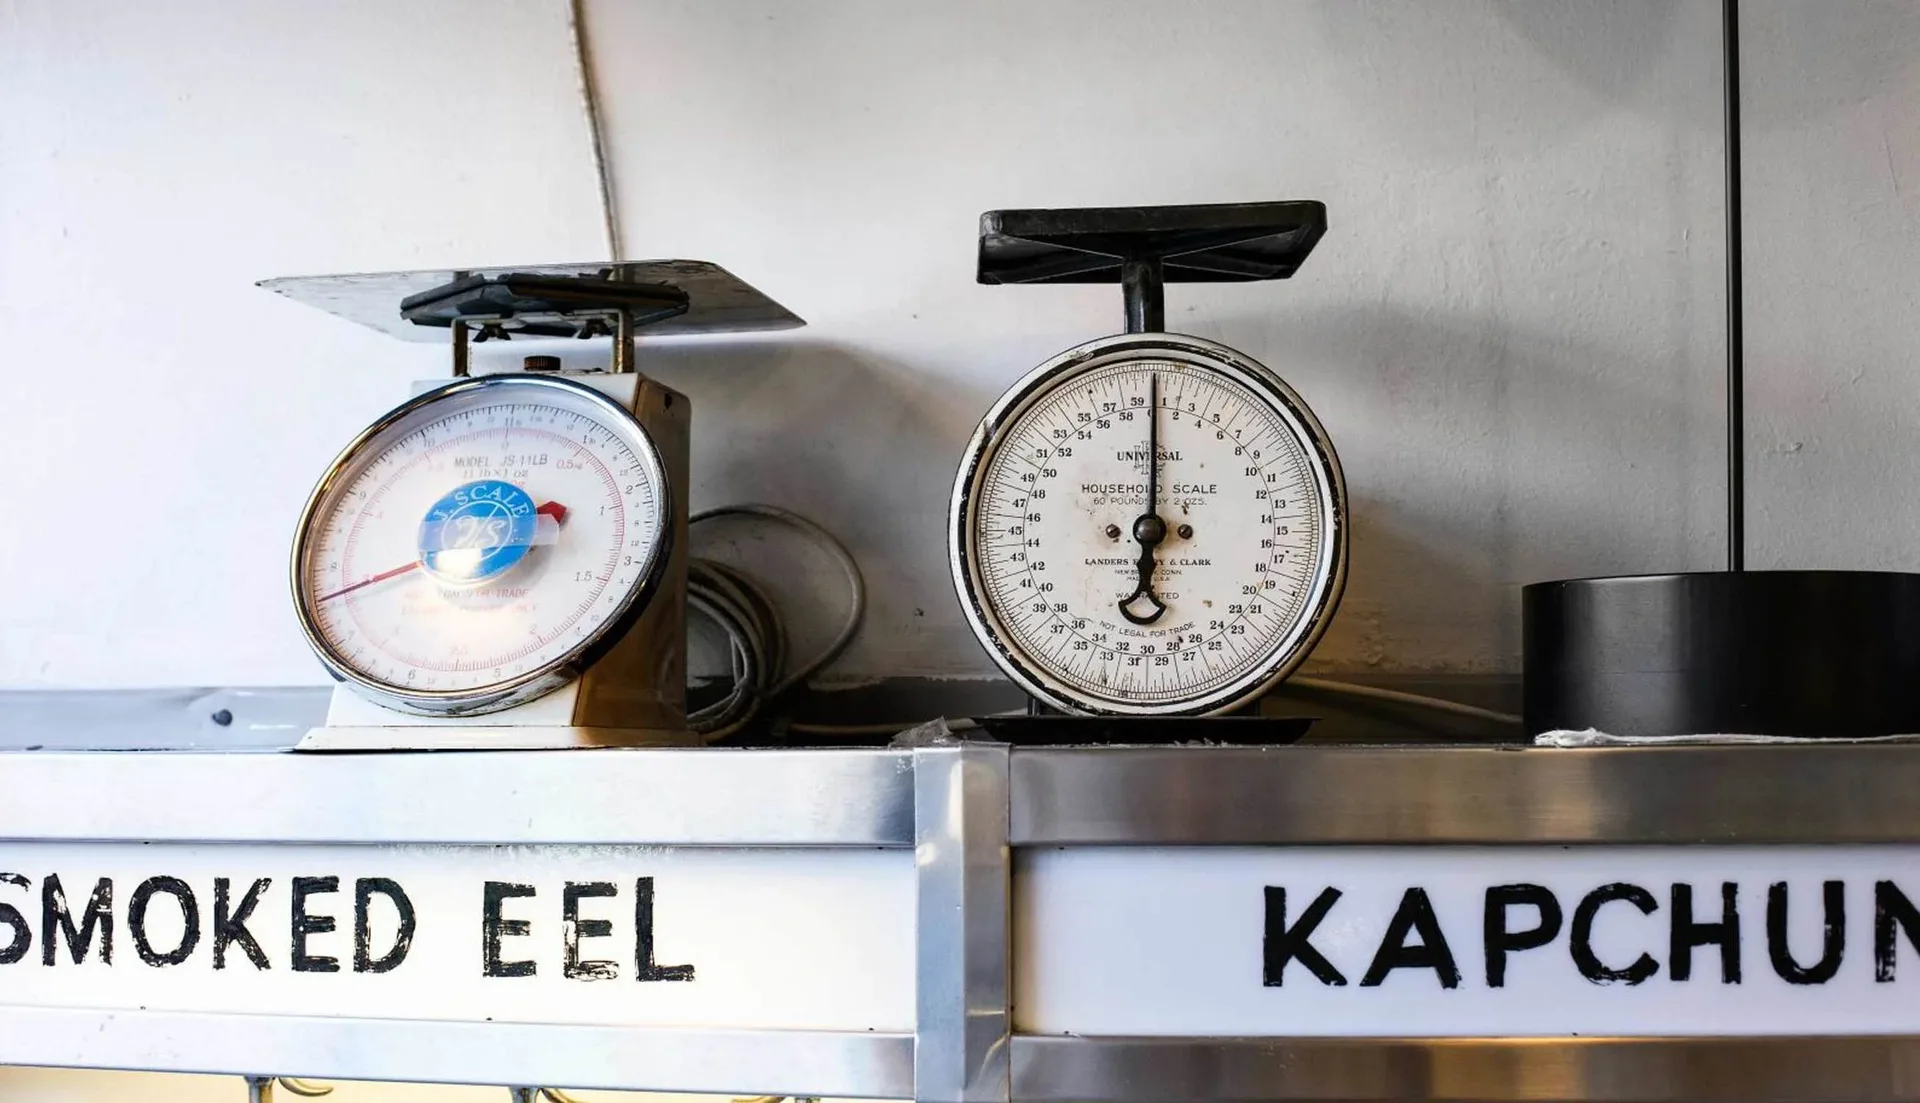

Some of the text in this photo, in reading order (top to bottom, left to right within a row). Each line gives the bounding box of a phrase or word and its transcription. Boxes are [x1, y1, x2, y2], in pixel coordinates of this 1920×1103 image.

[1131, 397, 1145, 406] 59
[1162, 397, 1167, 406] 1
[1103, 403, 1116, 412] 57
[1189, 403, 1195, 412] 3
[1078, 413, 1091, 422] 55
[1119, 412, 1133, 421] 58
[1173, 412, 1179, 420] 2
[1213, 414, 1220, 423] 5
[1096, 420, 1110, 429] 56
[1195, 420, 1201, 429] 4
[1054, 430, 1067, 439] 53
[1078, 431, 1092, 439] 54
[1217, 430, 1223, 439] 6
[1236, 430, 1241, 439] 7
[1036, 449, 1048, 458] 51
[1058, 448, 1072, 457] 52
[1117, 451, 1183, 461] UNIVRSAL
[1235, 447, 1241, 456] 8
[1254, 451, 1260, 459] 9
[454, 456, 491, 468] MODEL
[1043, 469, 1057, 477] 50
[1245, 468, 1257, 476] 10
[1021, 473, 1035, 483] 49
[1267, 474, 1276, 483] 11
[625, 485, 634, 496] 2
[1082, 484, 1217, 494] HOUSEHOD SCALE
[1032, 490, 1046, 499] 48
[1256, 490, 1267, 499] 12
[454, 485, 528, 518] SCALE
[1013, 499, 1026, 508] 47
[1174, 497, 1179, 505] 2
[1275, 499, 1286, 509] 13
[1027, 513, 1040, 522] 46
[1261, 515, 1272, 524] 14
[1008, 526, 1022, 535] 45
[1277, 526, 1288, 535] 15
[1026, 538, 1040, 547] 44
[1261, 540, 1272, 548] 16
[624, 556, 632, 566] 3
[1010, 553, 1024, 562] 43
[1274, 554, 1284, 564] 17
[1031, 562, 1045, 571] 42
[1255, 563, 1266, 572] 18
[575, 571, 592, 582] 1.5
[1020, 579, 1032, 588] 41
[1040, 583, 1053, 592] 40
[1265, 581, 1275, 589] 19
[1242, 586, 1256, 595] 20
[1033, 604, 1046, 613] 39
[1054, 604, 1068, 613] 38
[1229, 604, 1242, 614] 22
[1250, 605, 1262, 613] 21
[1051, 625, 1064, 634] 37
[1071, 621, 1085, 630] 36
[1100, 620, 1116, 632] NOT
[1119, 628, 1147, 638] LEGAL
[1169, 621, 1196, 635] TRADE
[1210, 621, 1224, 630] 24
[1231, 625, 1245, 634] 23
[1092, 634, 1107, 643] 34
[1189, 634, 1203, 643] 26
[1074, 641, 1088, 650] 35
[1116, 642, 1130, 651] 32
[1141, 645, 1154, 654] 30
[1167, 642, 1180, 651] 28
[1209, 641, 1222, 650] 25
[1100, 652, 1114, 661] 33
[1128, 657, 1140, 665] 31
[1155, 657, 1169, 665] 29
[1183, 652, 1196, 661] 27
[483, 877, 697, 983] EEL
